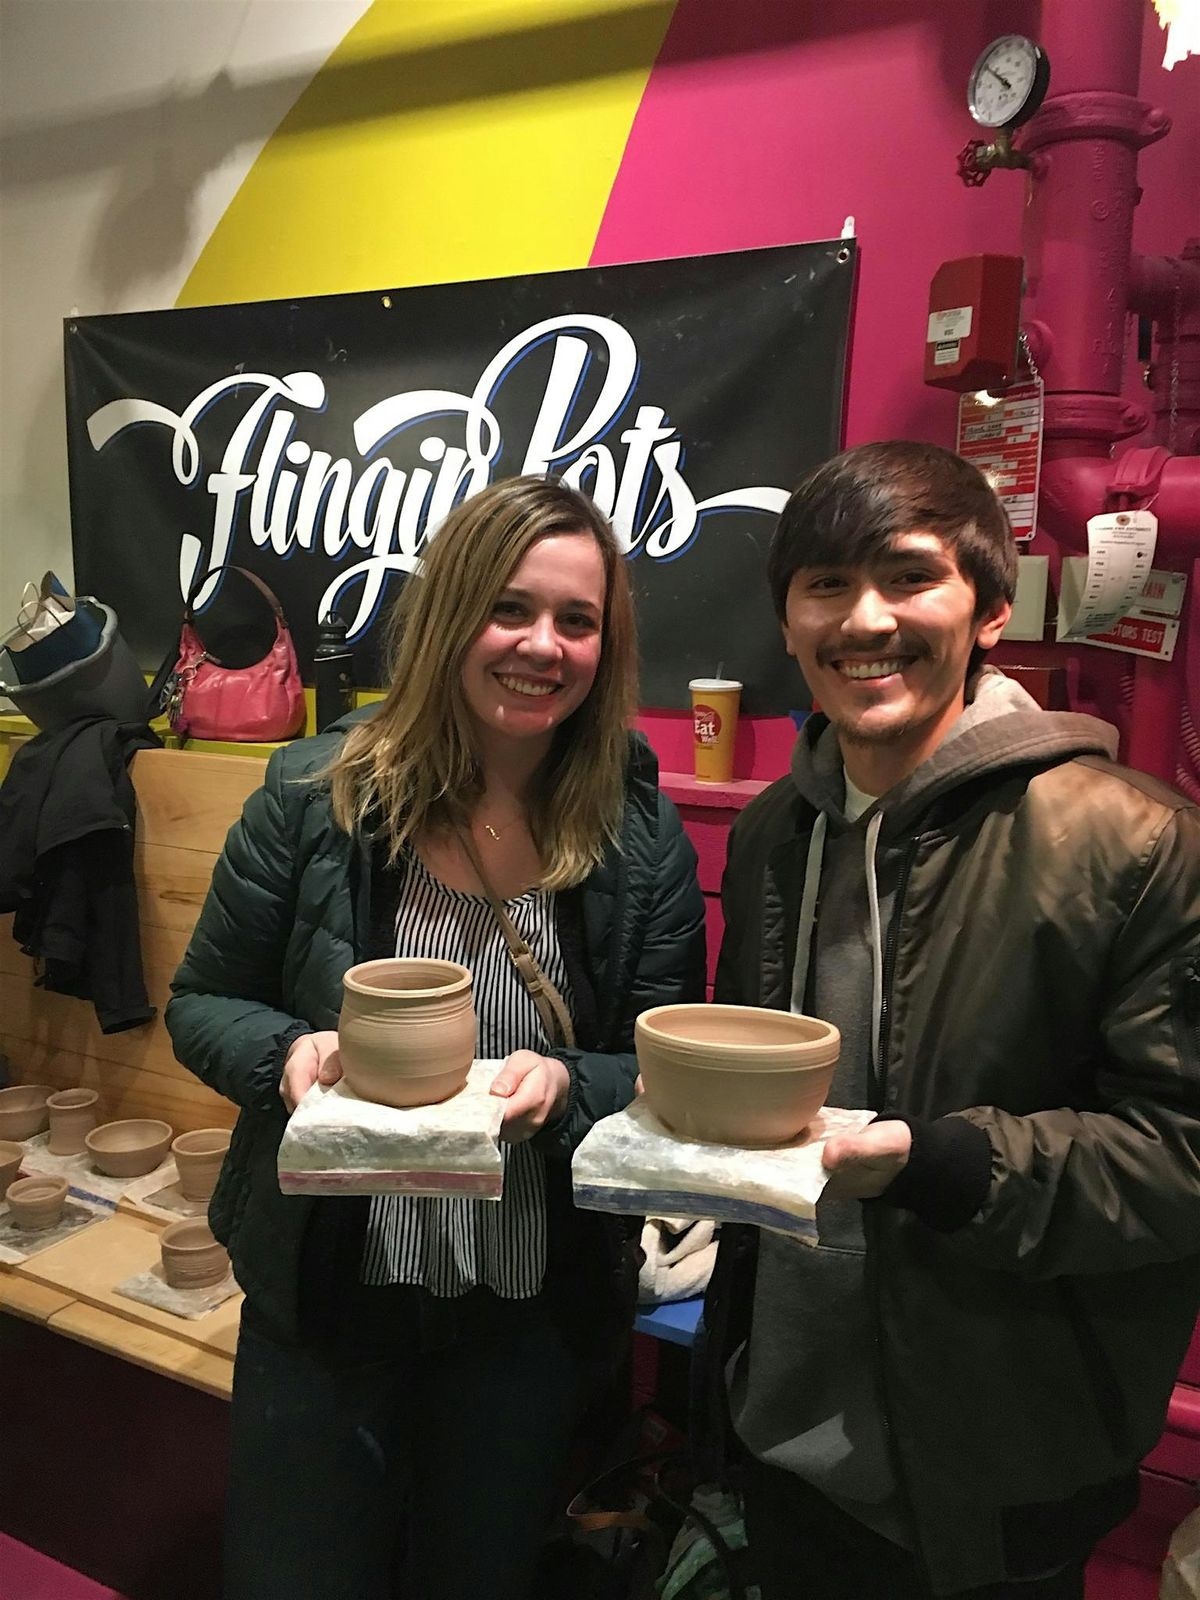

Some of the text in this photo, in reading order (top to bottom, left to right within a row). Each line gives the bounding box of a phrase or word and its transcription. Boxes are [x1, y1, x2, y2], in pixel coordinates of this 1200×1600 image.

[465, 313, 785, 562] Pots
[1141, 628, 1165, 645] TEST
[694, 719, 716, 737] Eat
